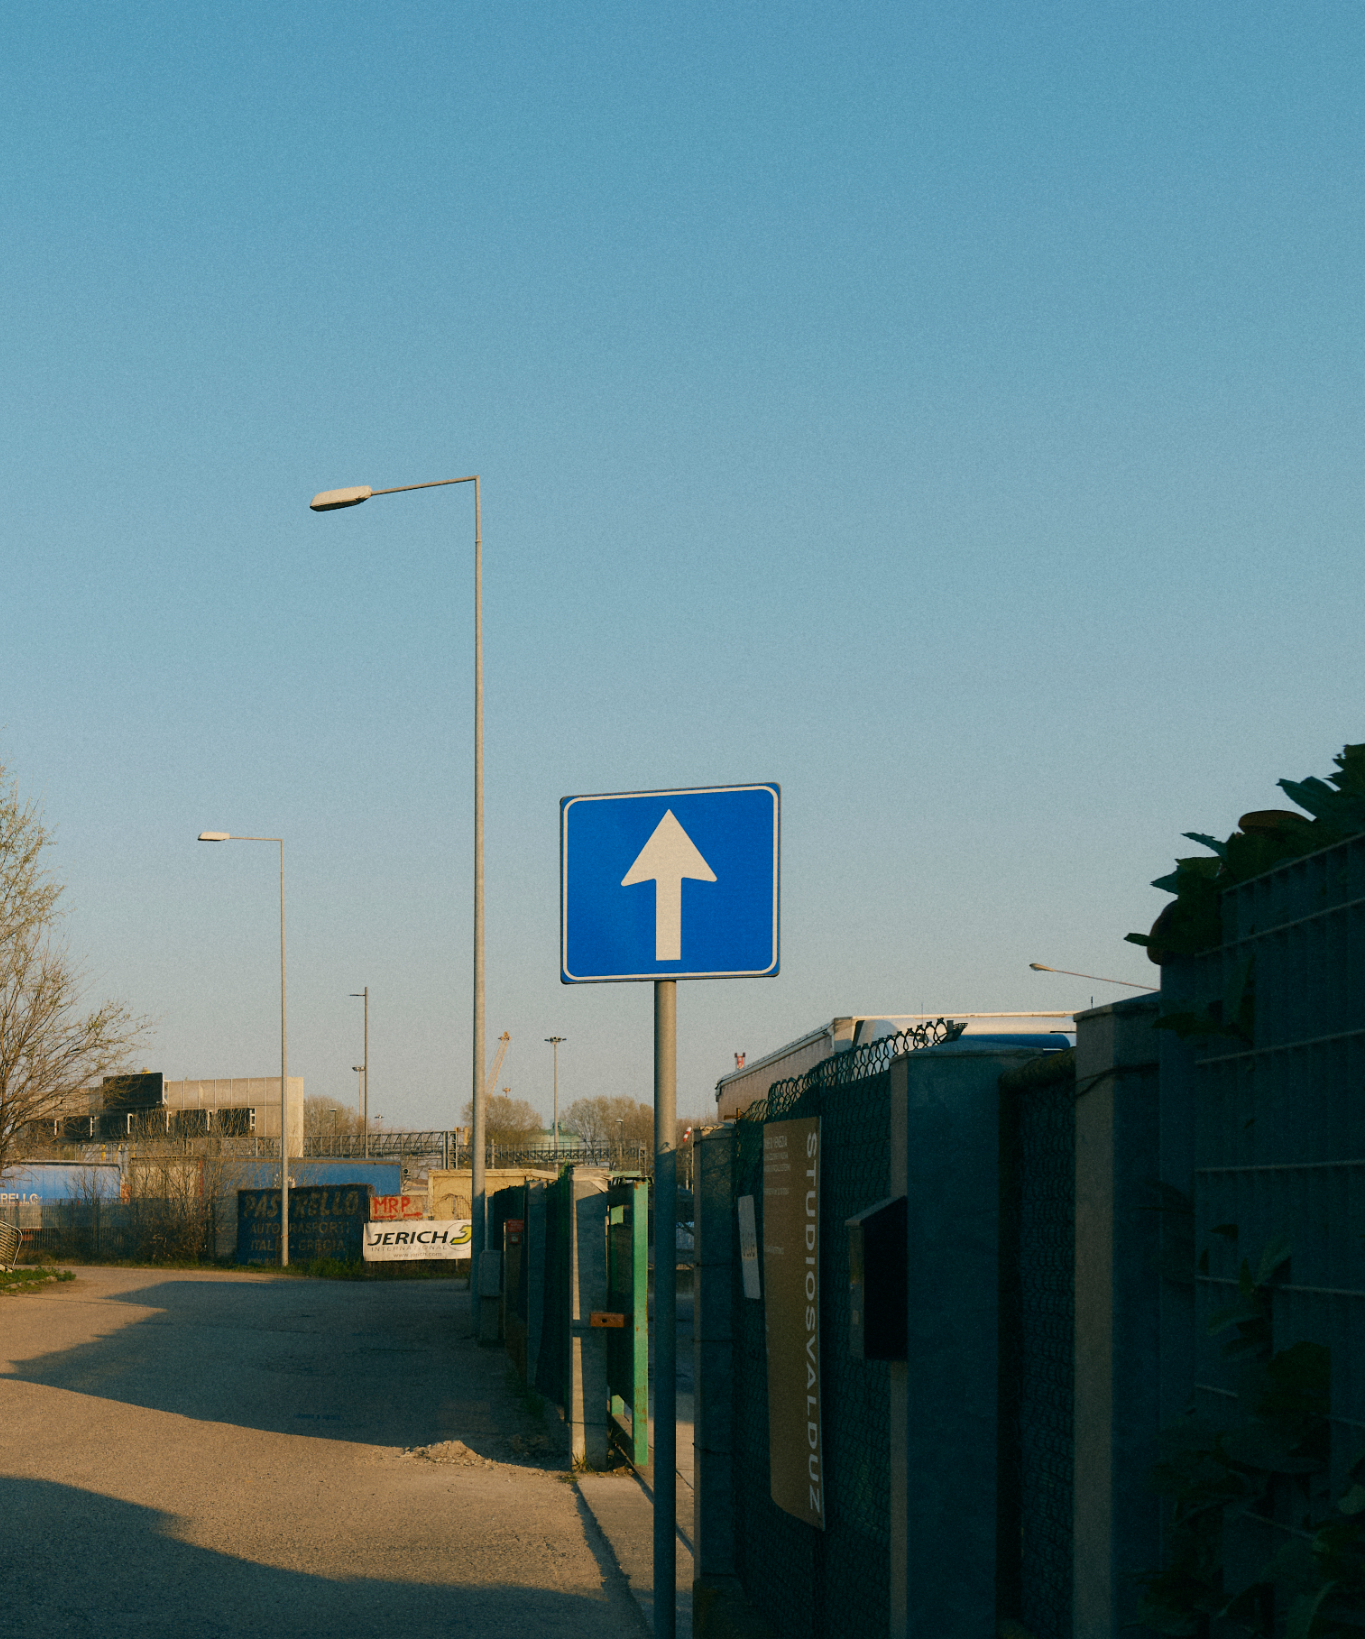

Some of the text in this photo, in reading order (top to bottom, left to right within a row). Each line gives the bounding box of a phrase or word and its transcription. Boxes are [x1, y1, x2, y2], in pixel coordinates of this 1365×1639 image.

[243, 1190, 360, 1218] PASRELLO
[373, 1196, 411, 1215] MRP
[367, 1230, 449, 1247] JERICH
